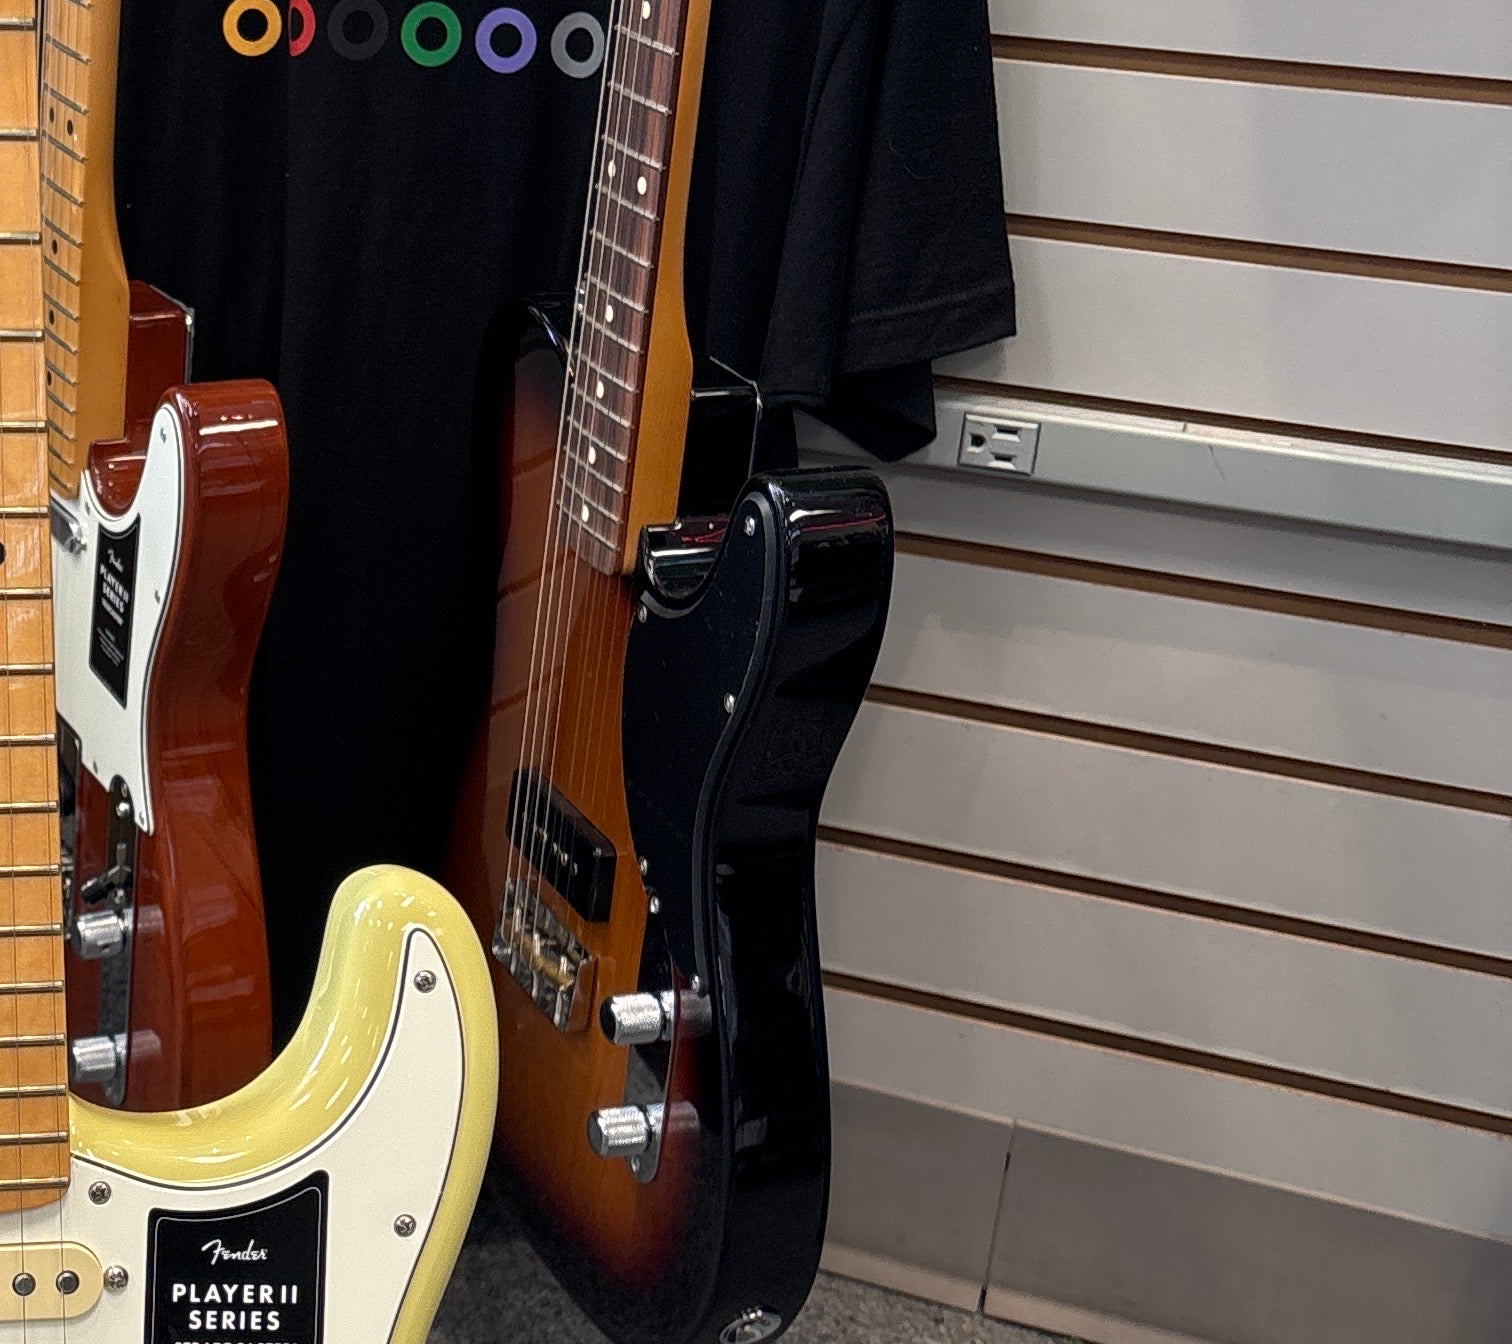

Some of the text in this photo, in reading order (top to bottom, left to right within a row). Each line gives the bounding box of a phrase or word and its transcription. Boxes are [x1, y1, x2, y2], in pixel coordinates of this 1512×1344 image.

[201, 1238, 268, 1266] Fender
[172, 1283, 298, 1304] PLAYER II
[188, 1309, 280, 1331] SERIES
